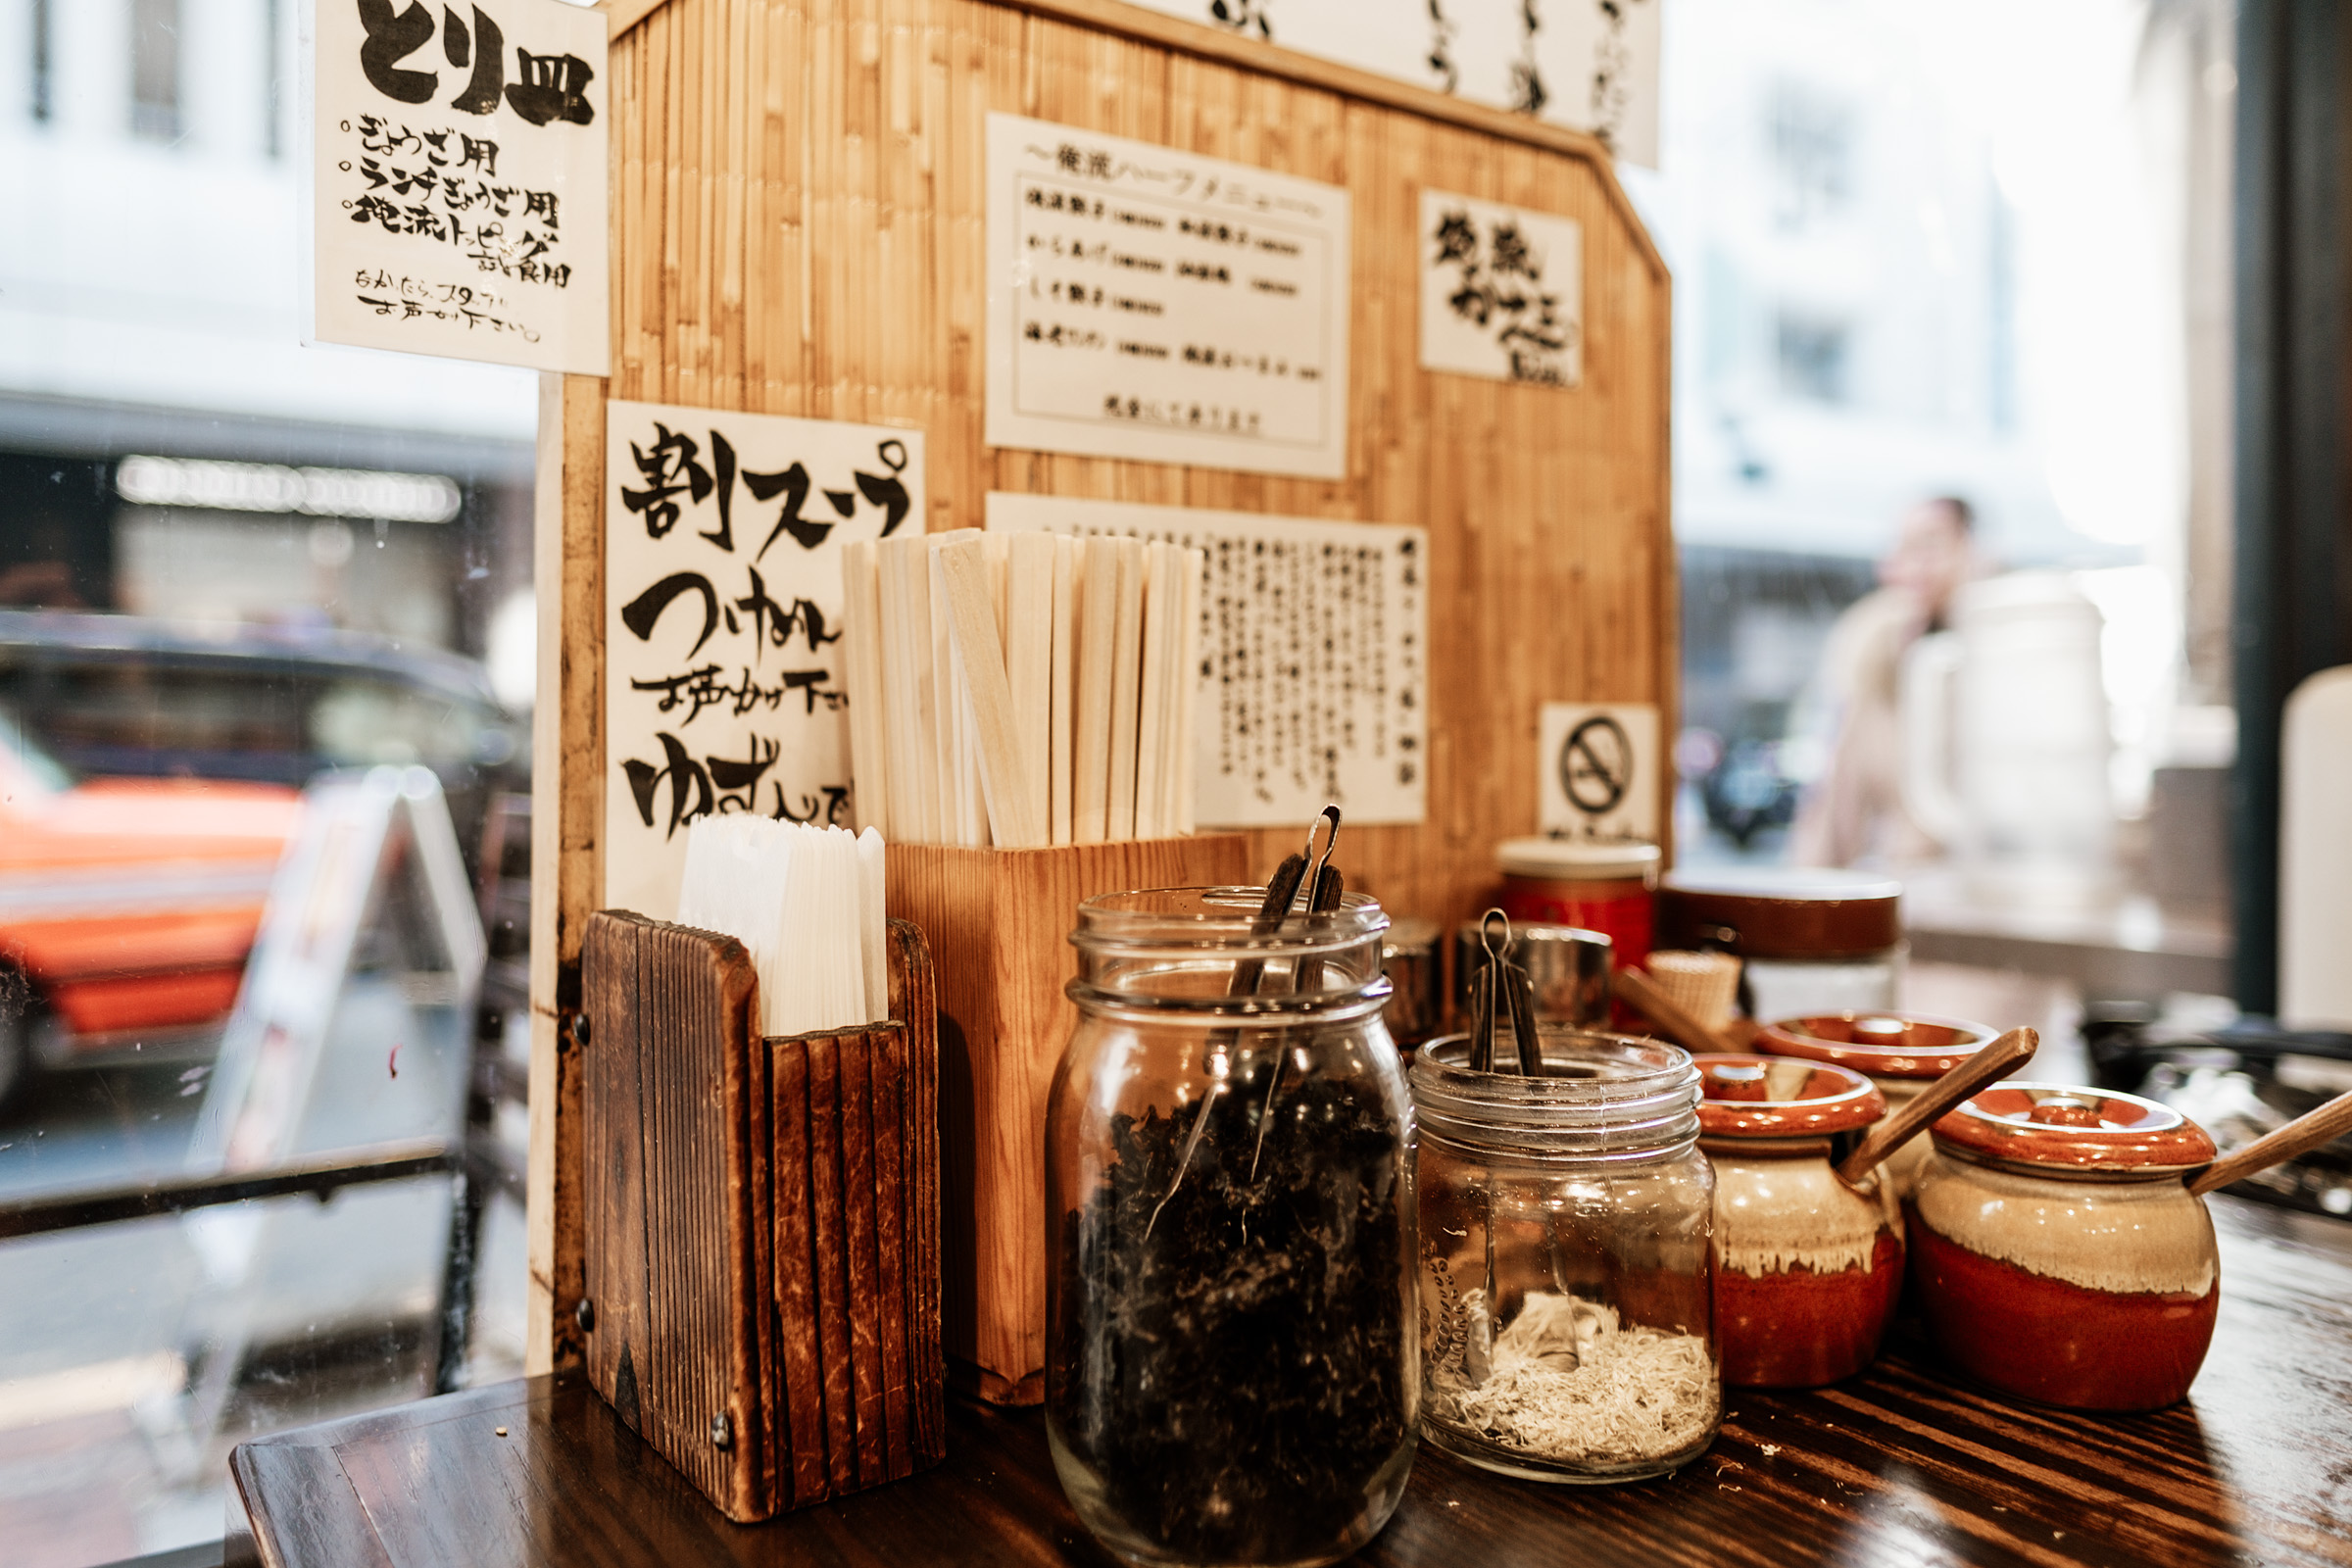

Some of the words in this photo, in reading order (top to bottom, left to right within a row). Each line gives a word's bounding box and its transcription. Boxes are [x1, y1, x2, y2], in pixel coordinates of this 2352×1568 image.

[358, 0, 596, 126] とり皿
[351, 194, 560, 261] 俺流トッピグ
[620, 421, 911, 563] 割スープ
[621, 564, 843, 662] つけめん
[619, 731, 855, 843] ゆず入りで
